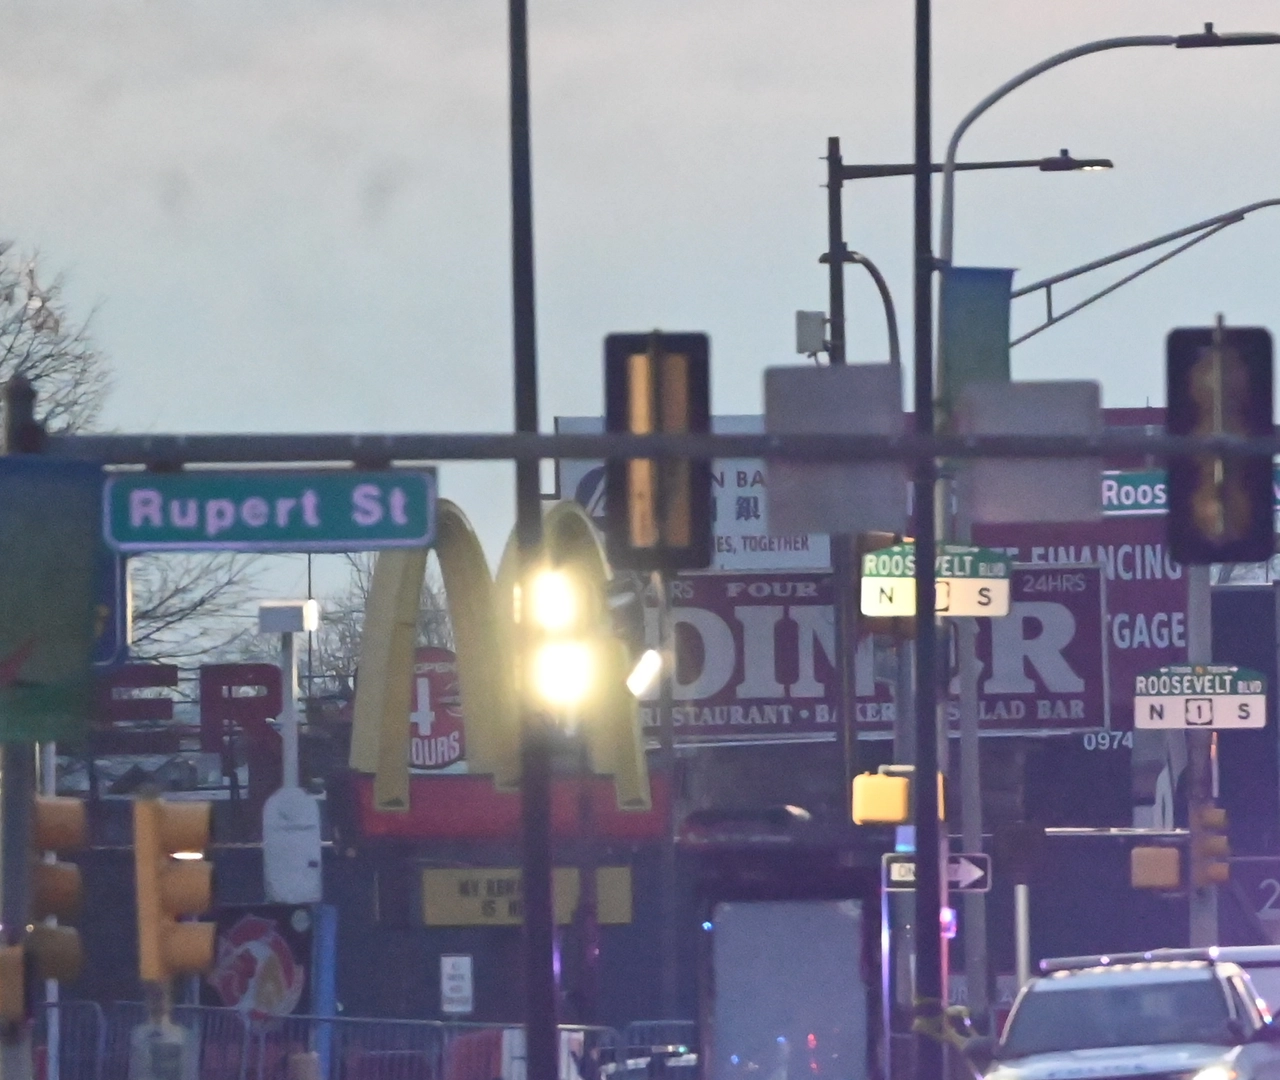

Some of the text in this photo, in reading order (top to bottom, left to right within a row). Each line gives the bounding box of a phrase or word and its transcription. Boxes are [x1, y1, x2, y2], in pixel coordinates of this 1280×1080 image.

[129, 483, 408, 537] Rupert St
[741, 535, 810, 552] TOGETHER
[726, 581, 819, 598] FOUR
[1023, 574, 1086, 593] 24HRS
[879, 586, 894, 604] N
[978, 587, 992, 606] S
[1112, 612, 1187, 649] GAGE
[1135, 675, 1262, 694] ROOSEVELT BLVD
[409, 677, 436, 737] 4
[1037, 700, 1085, 720] BAR
[1150, 704, 1164, 720] N
[1237, 703, 1251, 720] S
[411, 730, 460, 766] OURS
[1083, 731, 1133, 751] 0974
